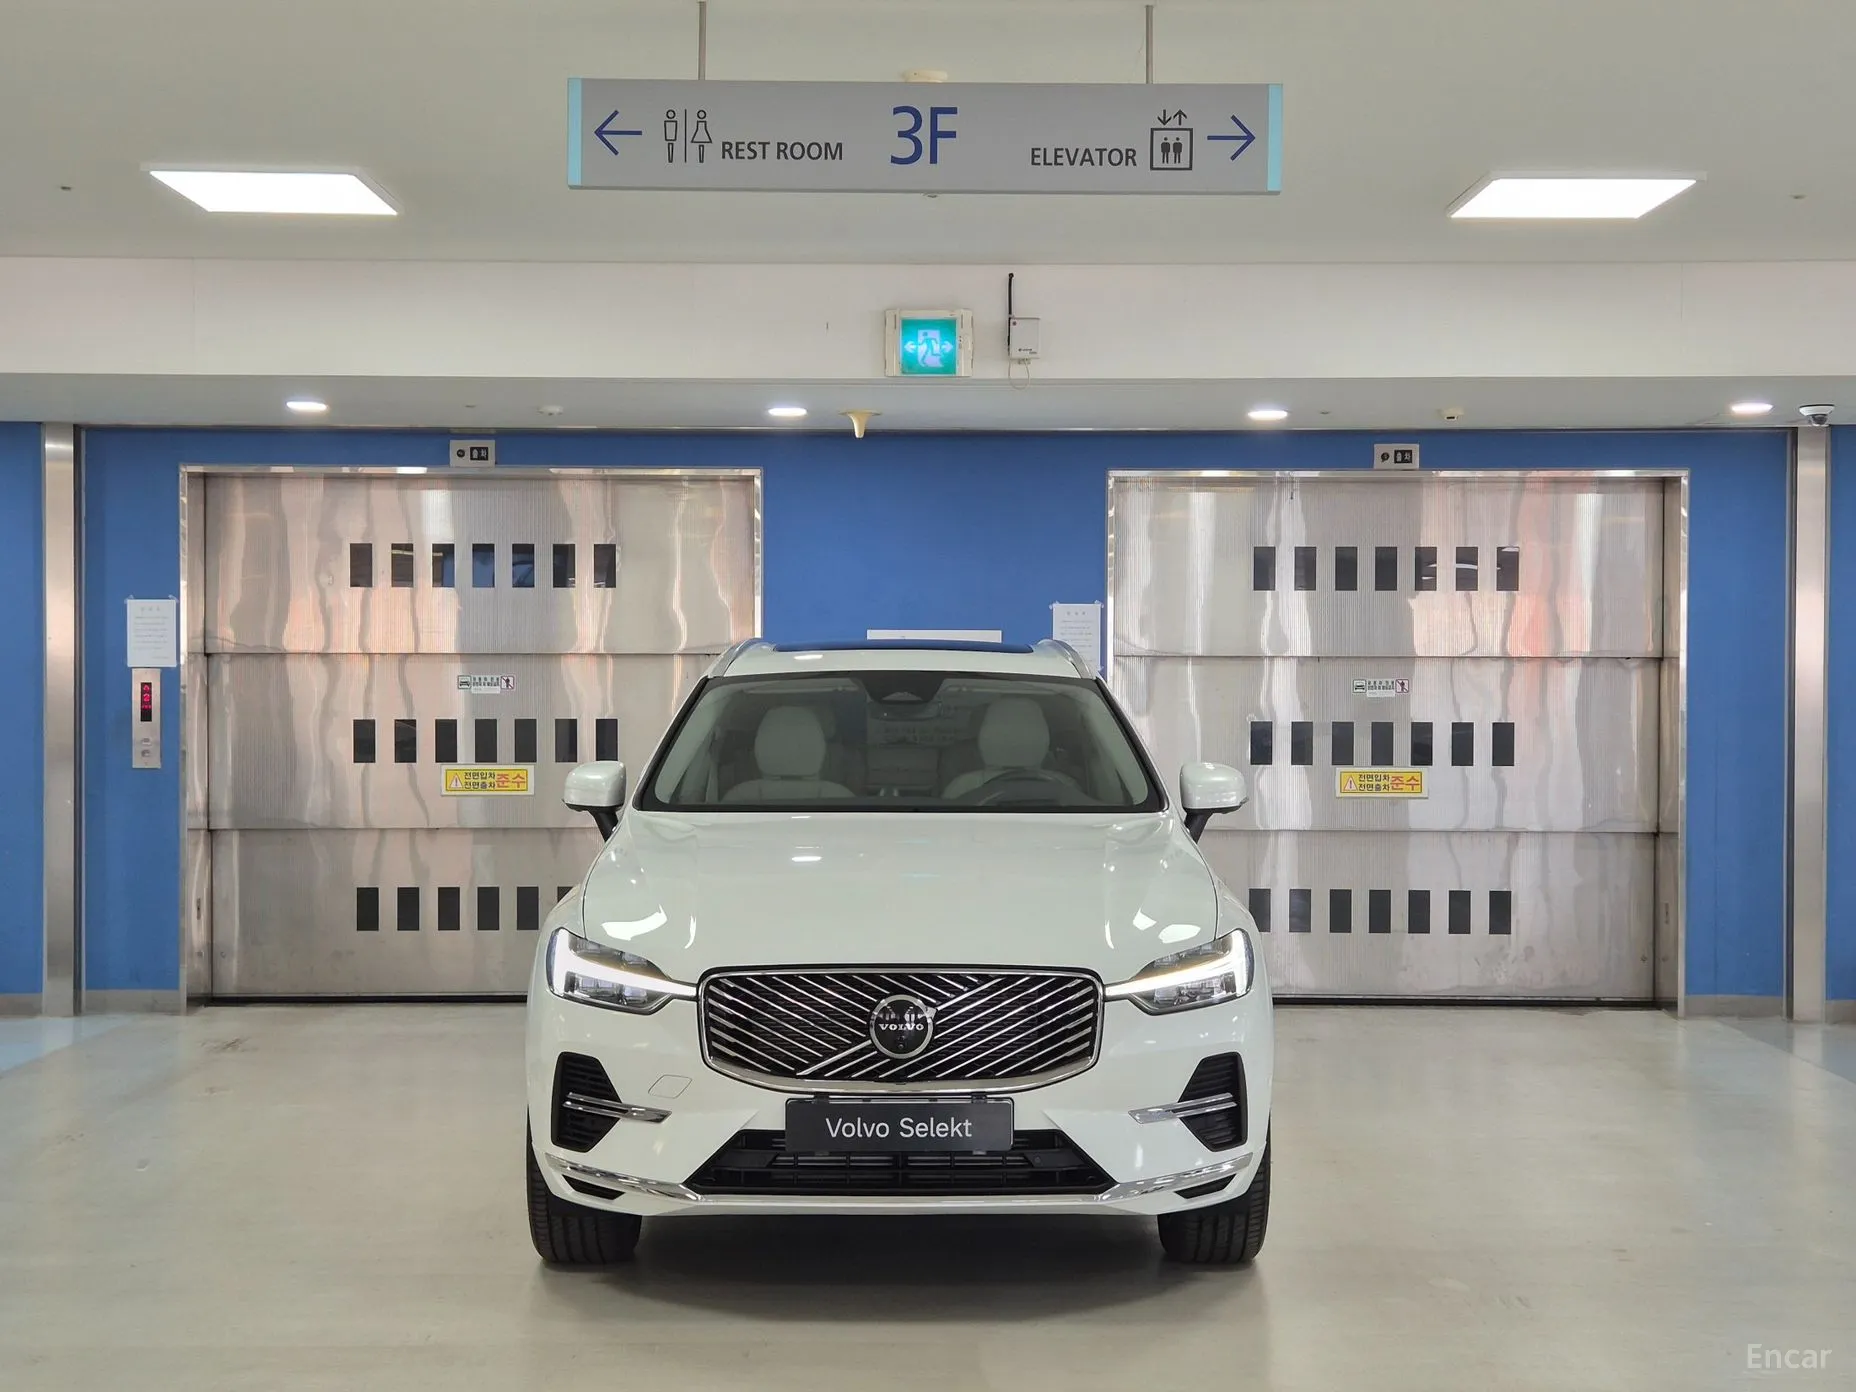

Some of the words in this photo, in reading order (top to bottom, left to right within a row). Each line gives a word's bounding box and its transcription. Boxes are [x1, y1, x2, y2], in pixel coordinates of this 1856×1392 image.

[890, 105, 958, 166] 3F
[721, 140, 771, 160] REST
[776, 141, 843, 161] ROOM
[1030, 147, 1137, 167] ELEVATOR
[464, 771, 496, 780] 전면입차
[496, 773, 526, 789] 준수
[1358, 773, 1390, 782] 전면입차
[1390, 775, 1420, 791] 준수
[878, 1023, 925, 1031] VOLVO
[825, 1117, 890, 1138] Volvo
[899, 1117, 972, 1138] Selekt
